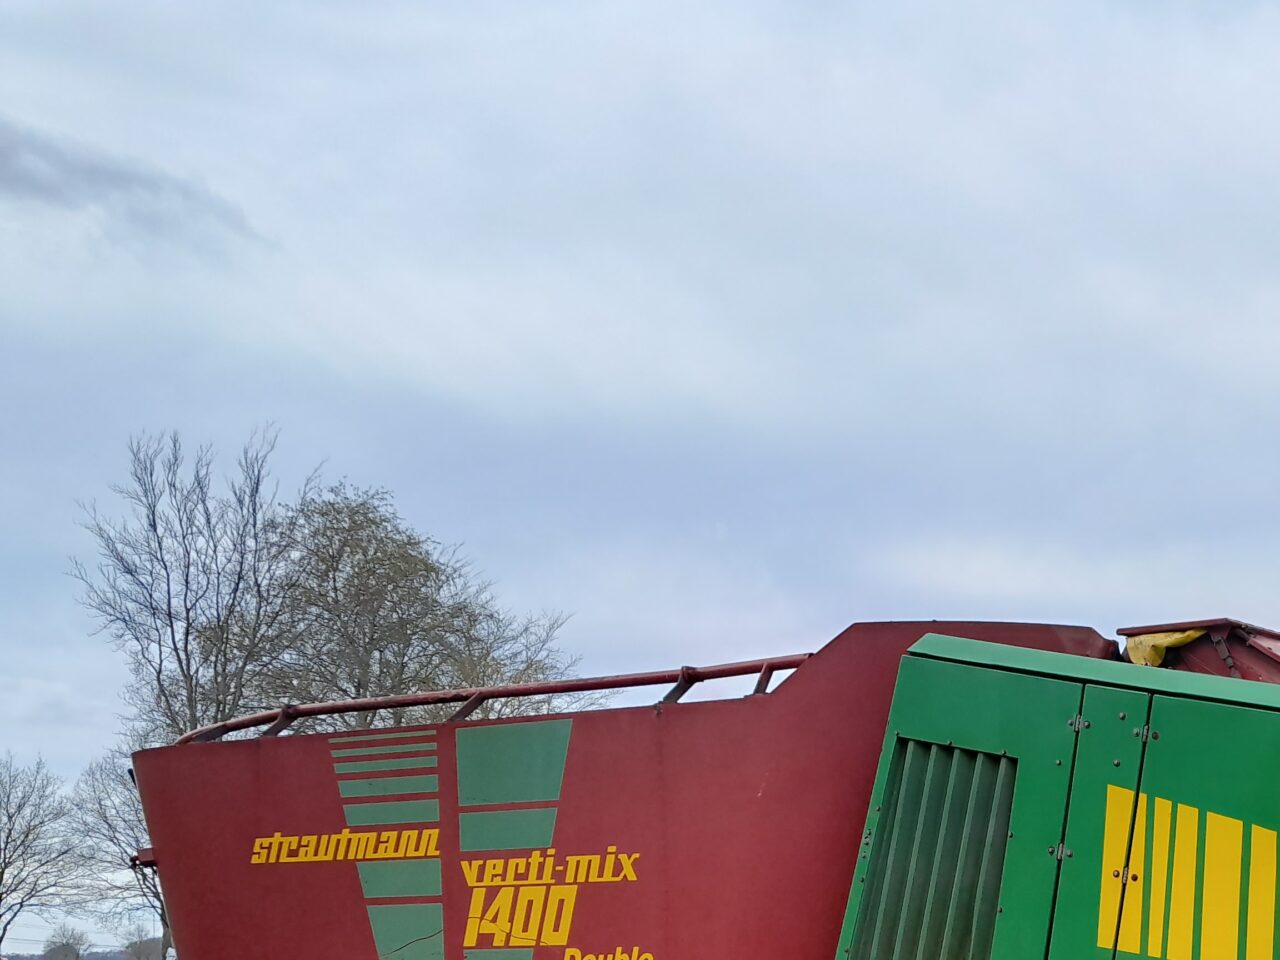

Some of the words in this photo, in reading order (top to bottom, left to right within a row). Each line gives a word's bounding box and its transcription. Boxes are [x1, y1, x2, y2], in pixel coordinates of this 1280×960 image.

[251, 828, 440, 864] strautmann
[460, 846, 640, 887] verti-mix
[463, 884, 578, 947] 1400
